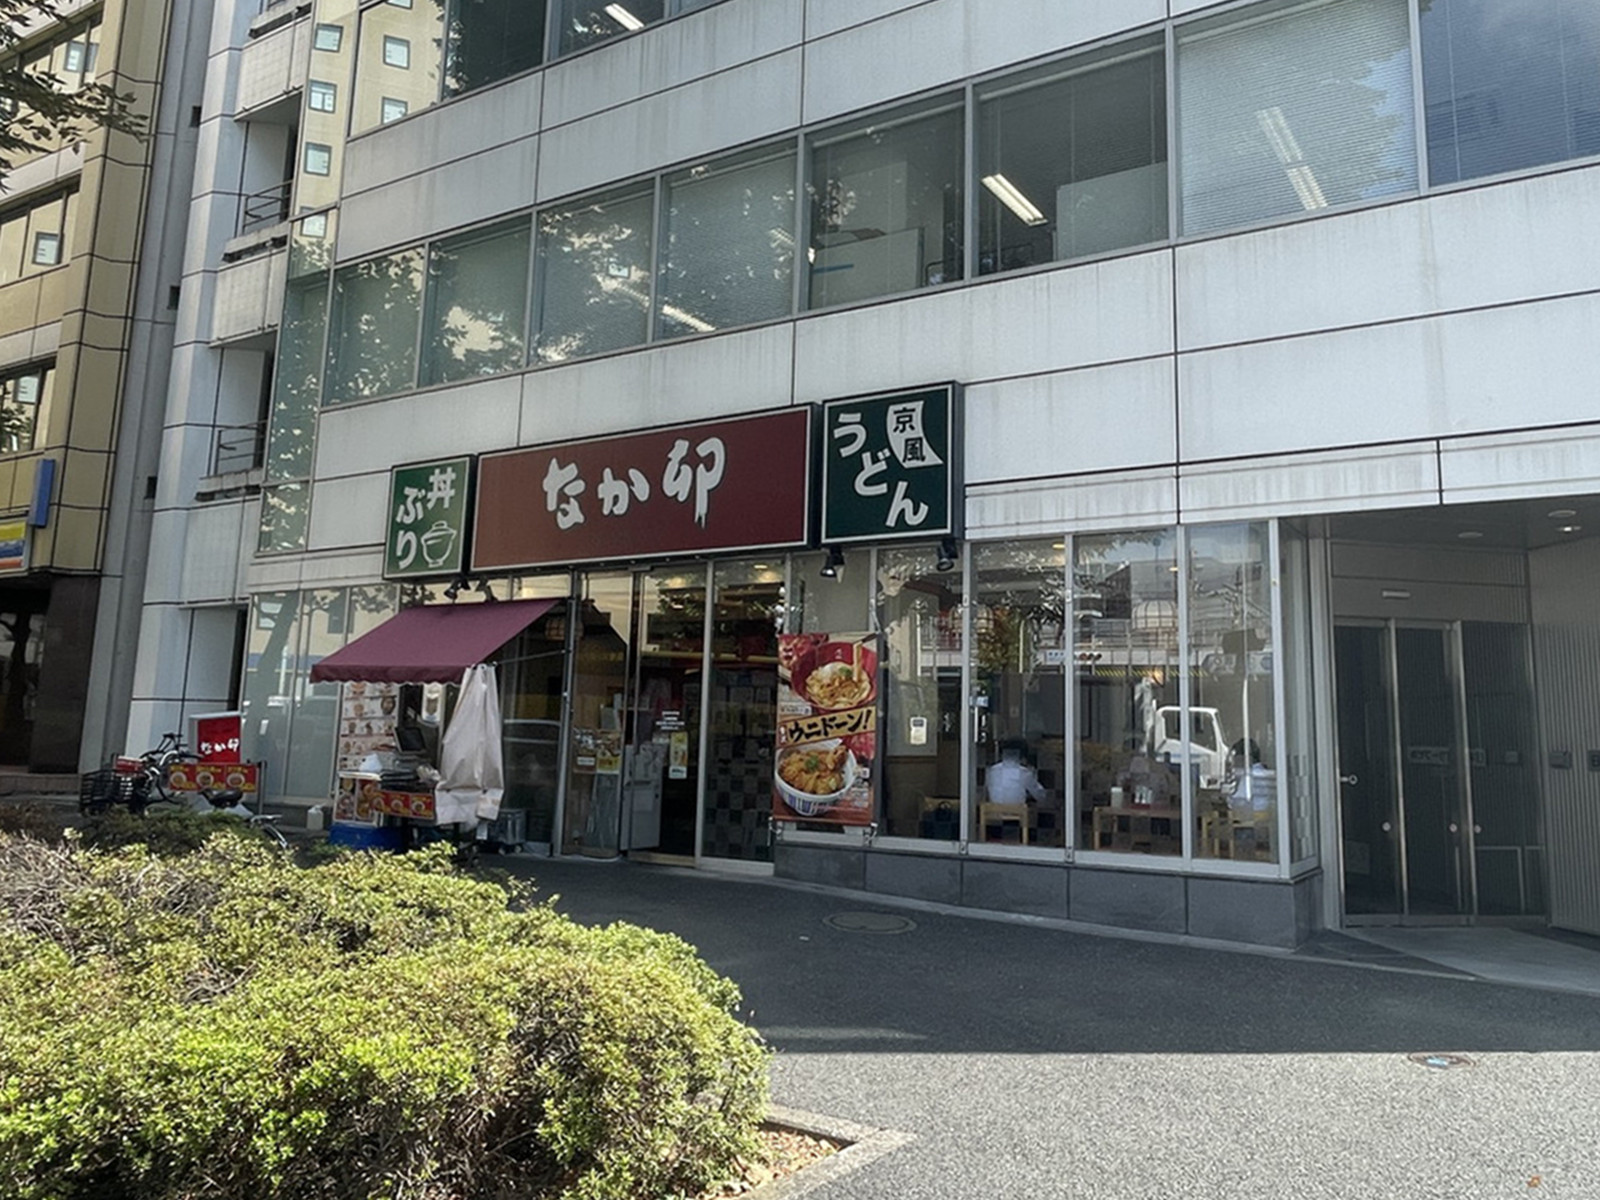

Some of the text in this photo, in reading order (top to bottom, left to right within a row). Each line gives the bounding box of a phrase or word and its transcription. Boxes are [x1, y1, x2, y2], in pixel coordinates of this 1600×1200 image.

[833, 412, 929, 528] うどん
[893, 407, 926, 463] 京風
[542, 436, 726, 530] なか卯
